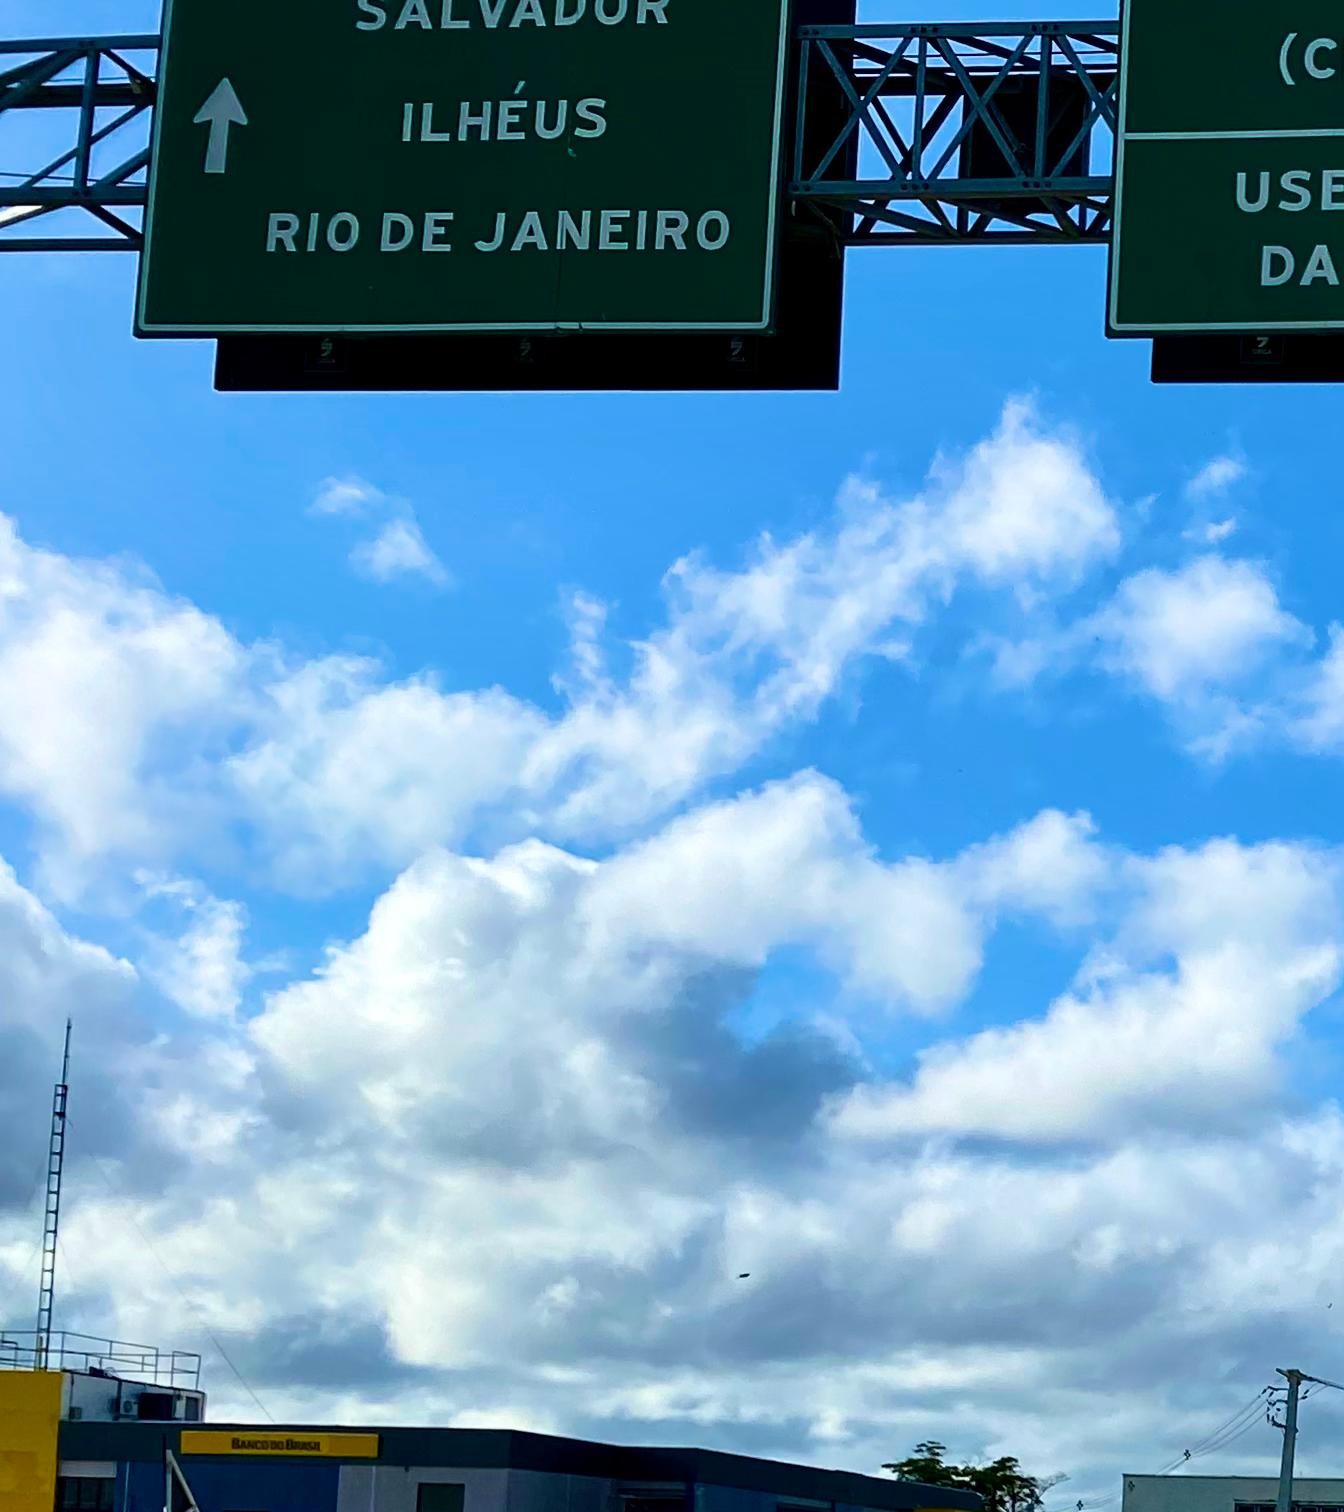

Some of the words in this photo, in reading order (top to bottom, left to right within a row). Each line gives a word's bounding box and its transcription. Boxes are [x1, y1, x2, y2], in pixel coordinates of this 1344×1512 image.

[356, 0, 668, 29] SALVADOR
[402, 80, 607, 142] ILHÉUS
[266, 212, 359, 253] RIO
[380, 212, 454, 252] DE
[474, 210, 730, 252] JANEIRO
[1260, 245, 1339, 287] DA
